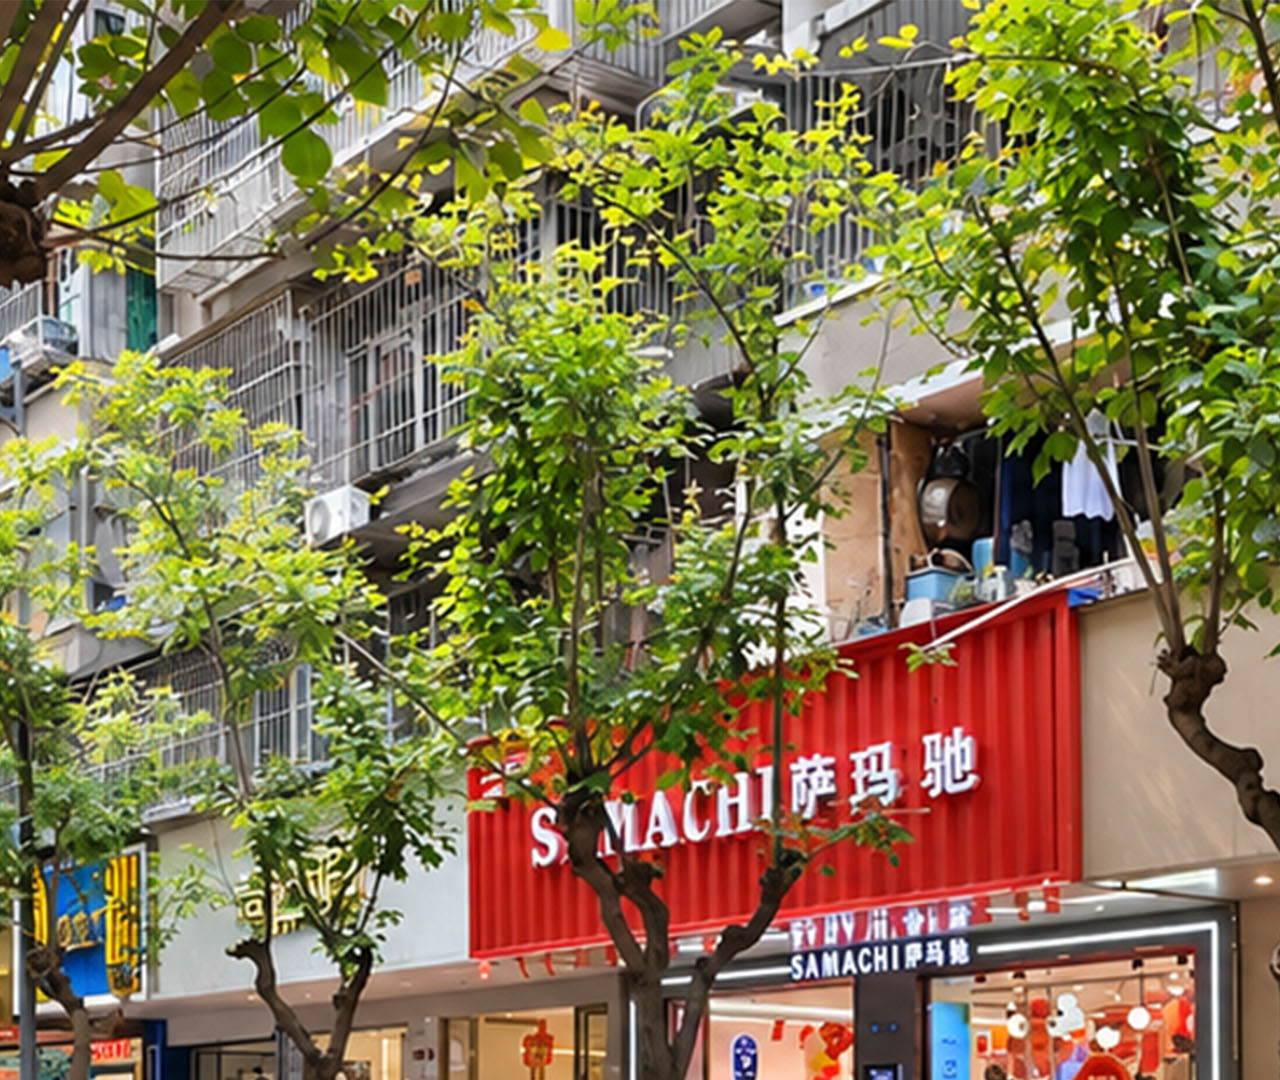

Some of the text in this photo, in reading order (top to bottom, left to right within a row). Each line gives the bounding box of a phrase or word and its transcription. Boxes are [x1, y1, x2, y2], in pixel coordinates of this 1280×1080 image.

[530, 725, 979, 868] SMACHI 萨玛驰
[790, 944, 900, 980] SAMACHI
